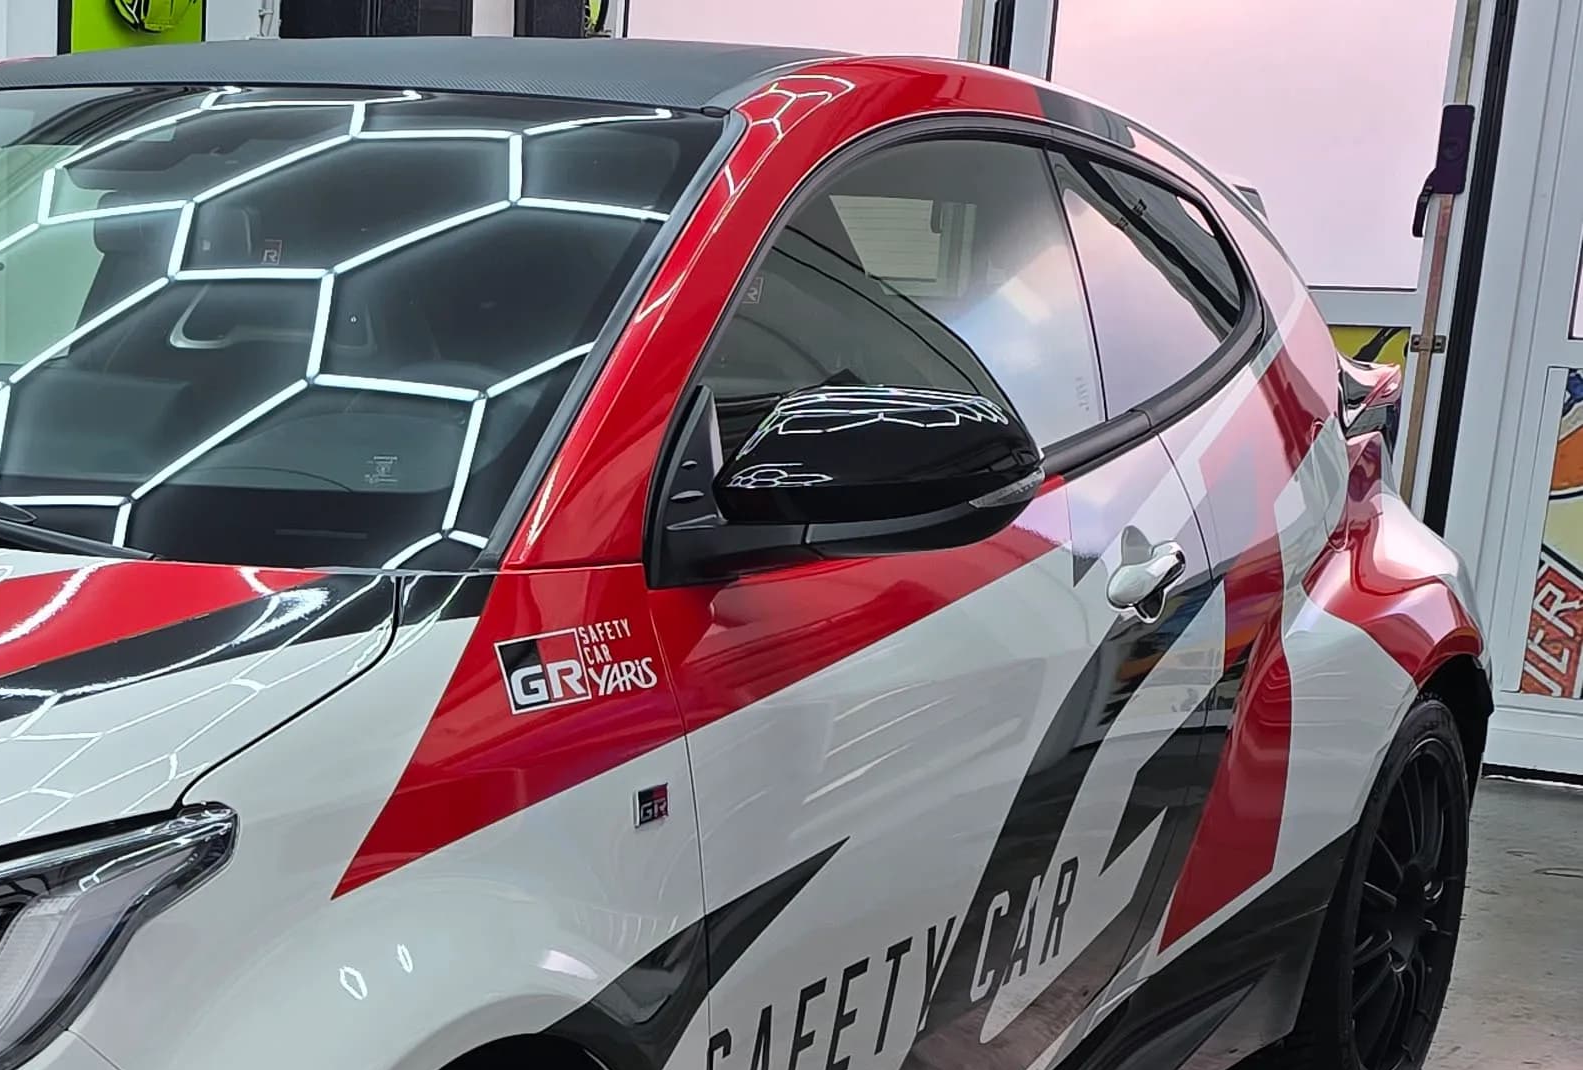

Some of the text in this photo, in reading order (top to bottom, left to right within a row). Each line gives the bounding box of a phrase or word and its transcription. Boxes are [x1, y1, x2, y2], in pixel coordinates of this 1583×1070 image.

[578, 618, 631, 645] SAFETY
[583, 643, 613, 665] CAR
[510, 659, 586, 706] GR
[640, 799, 668, 821] GR
[970, 856, 1080, 1003] CAR
